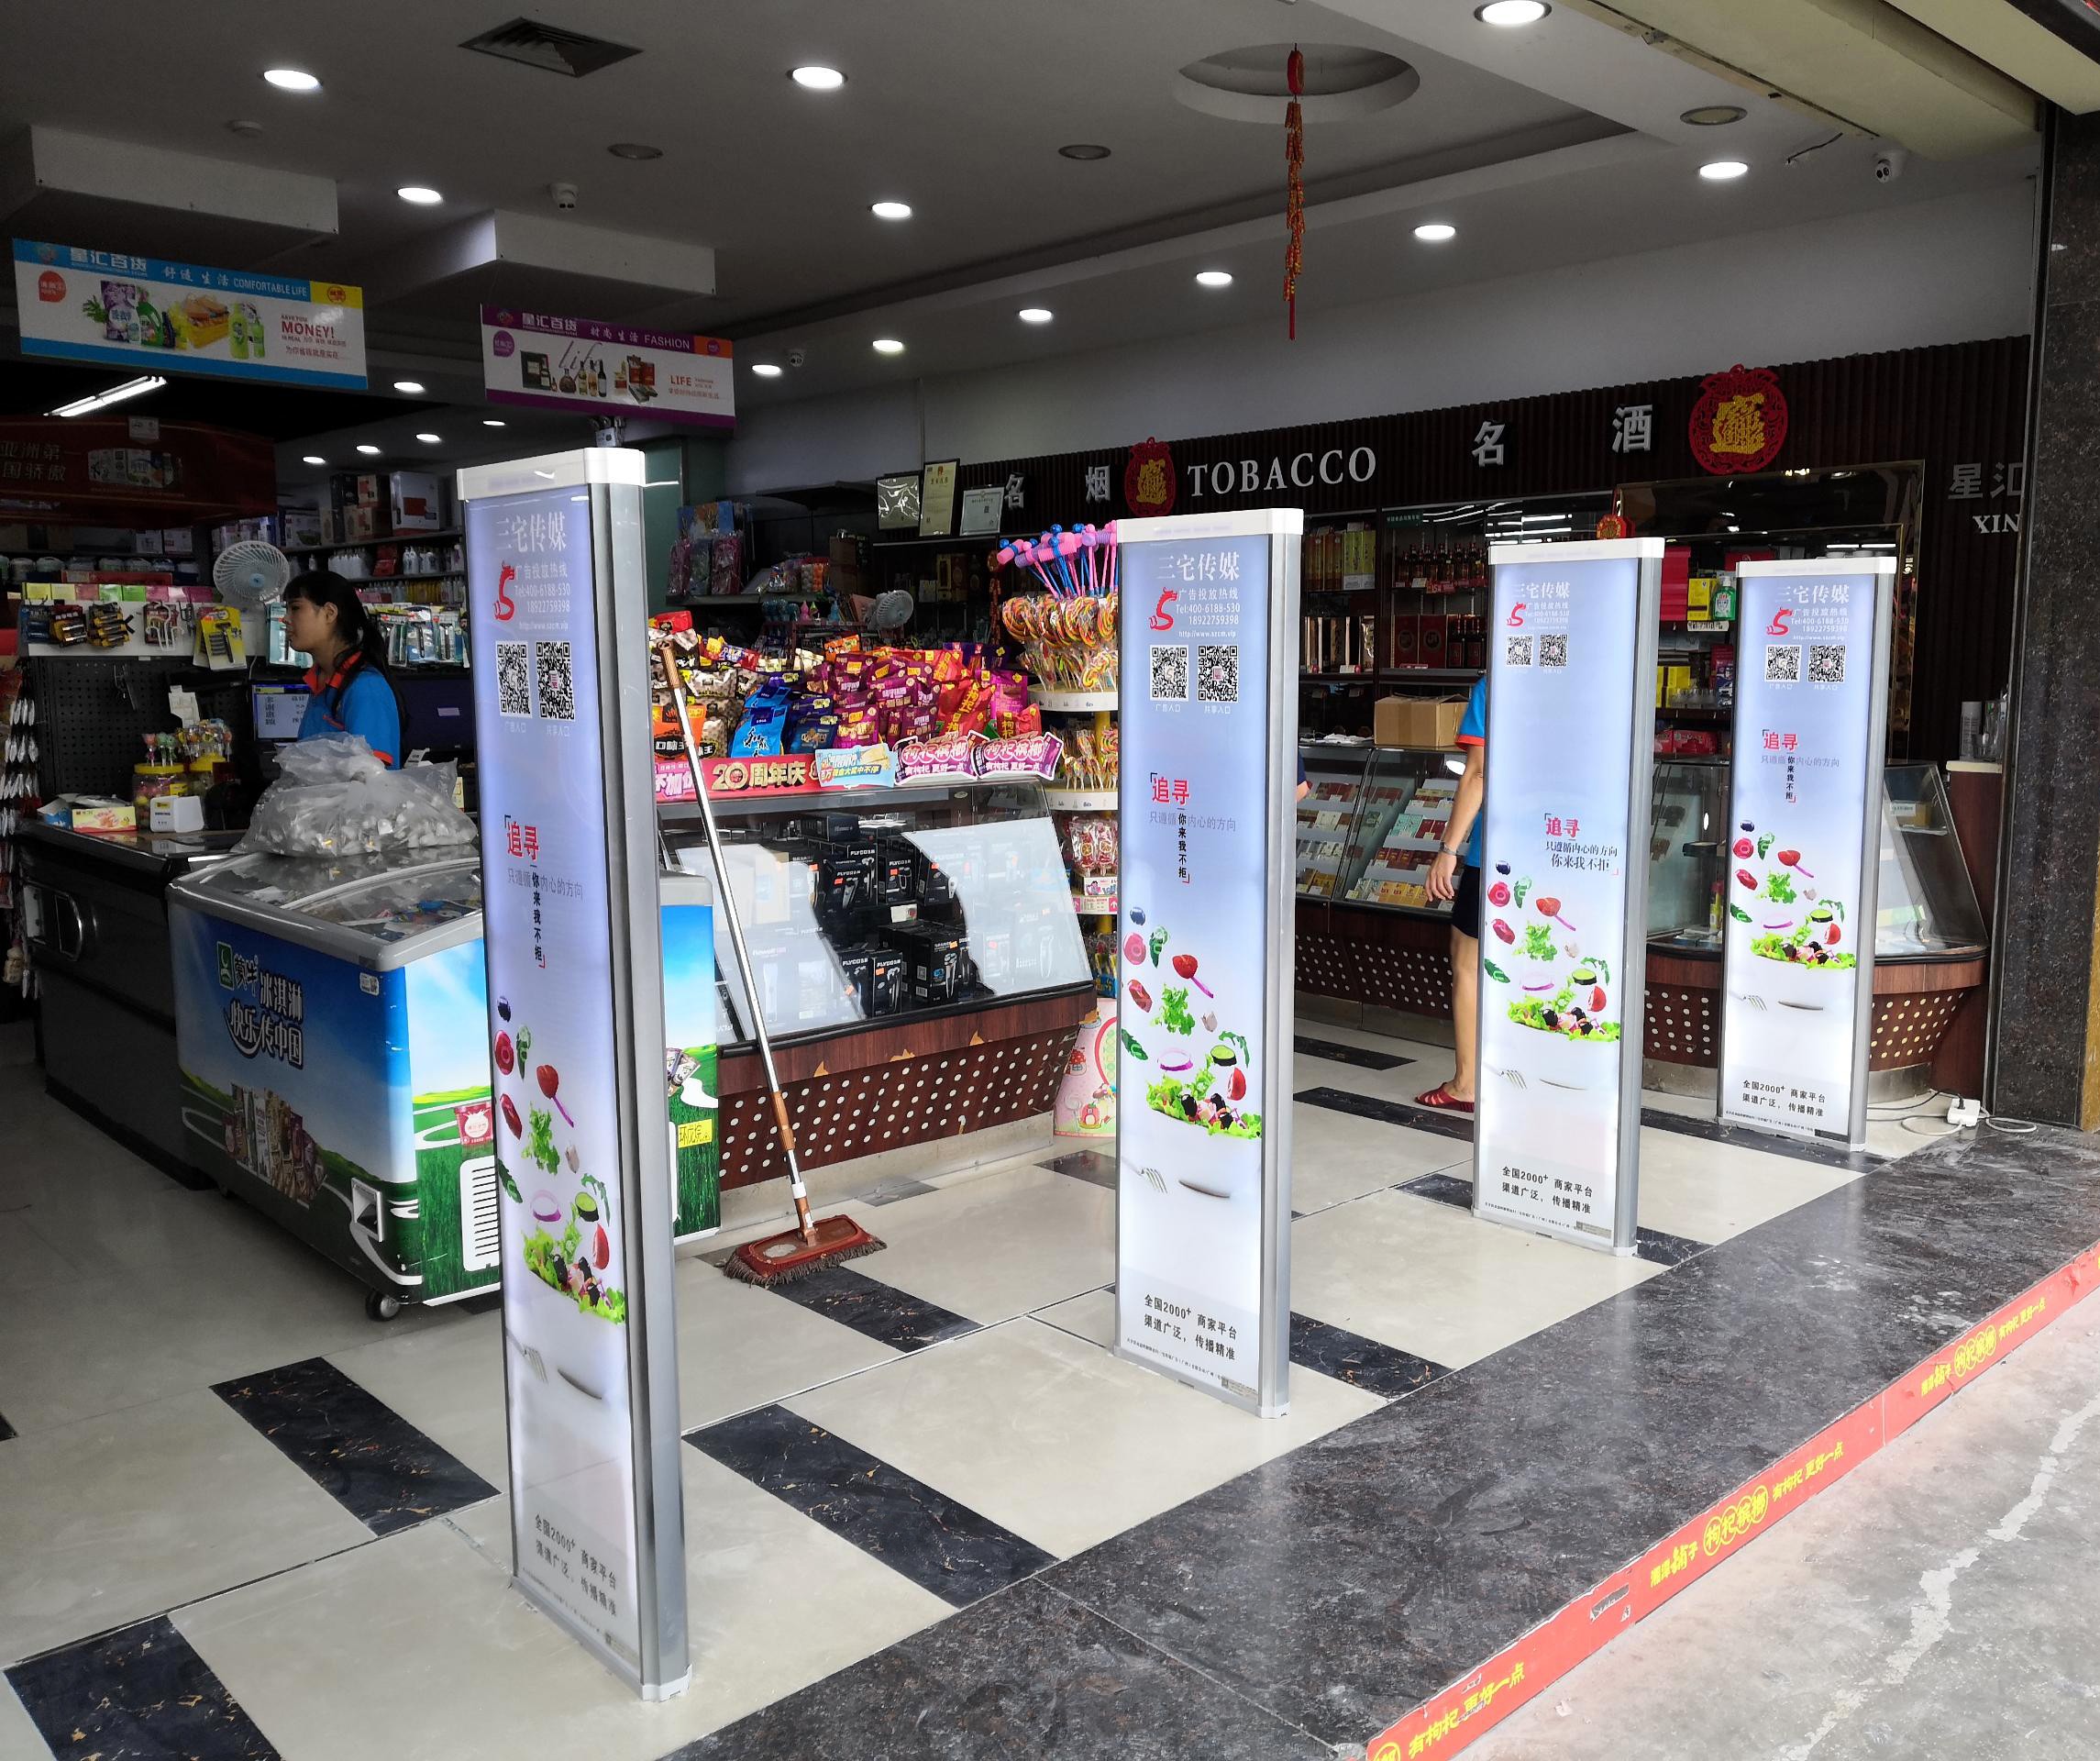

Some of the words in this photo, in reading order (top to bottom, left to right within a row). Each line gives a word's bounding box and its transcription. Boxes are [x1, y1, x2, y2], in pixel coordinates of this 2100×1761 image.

[233, 277, 291, 294] COMFORTABLE
[293, 285, 307, 296] LIFE
[282, 321, 335, 338] MONEY!
[644, 334, 690, 349] FASHION
[670, 375, 691, 386] LIFE
[1471, 420, 1506, 467] 名
[1612, 404, 1652, 452] 酒
[1188, 446, 1376, 497] TOBACCO
[1004, 473, 1026, 510] 名
[1086, 465, 1111, 503] 烟
[496, 512, 567, 552] 三宅传媒
[1973, 514, 2019, 533] XIN
[1155, 551, 1240, 581] 三宅传媒
[1177, 587, 1238, 601] 广告投放热线
[1510, 582, 1570, 599] 三宅传媒
[1774, 584, 1849, 604] 三宅传媒
[1176, 604, 1240, 614] Tel:400-6188-530
[1188, 615, 1239, 626] 18922759398
[901, 737, 969, 764] 枸杞槟榔
[984, 737, 1044, 761] 枸杞槟榔
[1763, 732, 1797, 751] 追寻
[712, 761, 807, 790] 20周年庆
[821, 769, 832, 781] 百万
[1786, 756, 1795, 800] 你来我不拒
[1152, 777, 1190, 805] 追寻
[1546, 817, 1580, 838] 追寻
[506, 821, 539, 860] 追寻
[1178, 813, 1187, 878] 你来我不拒
[1552, 853, 1609, 871] 你来我不拒
[532, 872, 543, 961] 你来我不拒
[260, 971, 302, 1022] 冰淇淋
[230, 1000, 302, 1066] 快乐传中国
[1790, 1089, 1826, 1103] 商家平台
[1788, 1102, 1824, 1116] 传播精准
[1553, 1179, 1593, 1198] 商家平台
[1553, 1195, 1591, 1214] 传播精准
[1197, 1313, 1237, 1340] 商家平台
[1196, 1335, 1235, 1360] 传播精准
[1805, 1442, 1843, 1480] 更好一点
[580, 1549, 617, 1590] 商家平台
[580, 1578, 617, 1617] 传播精准
[1409, 1708, 1459, 1759] 有枸杞
